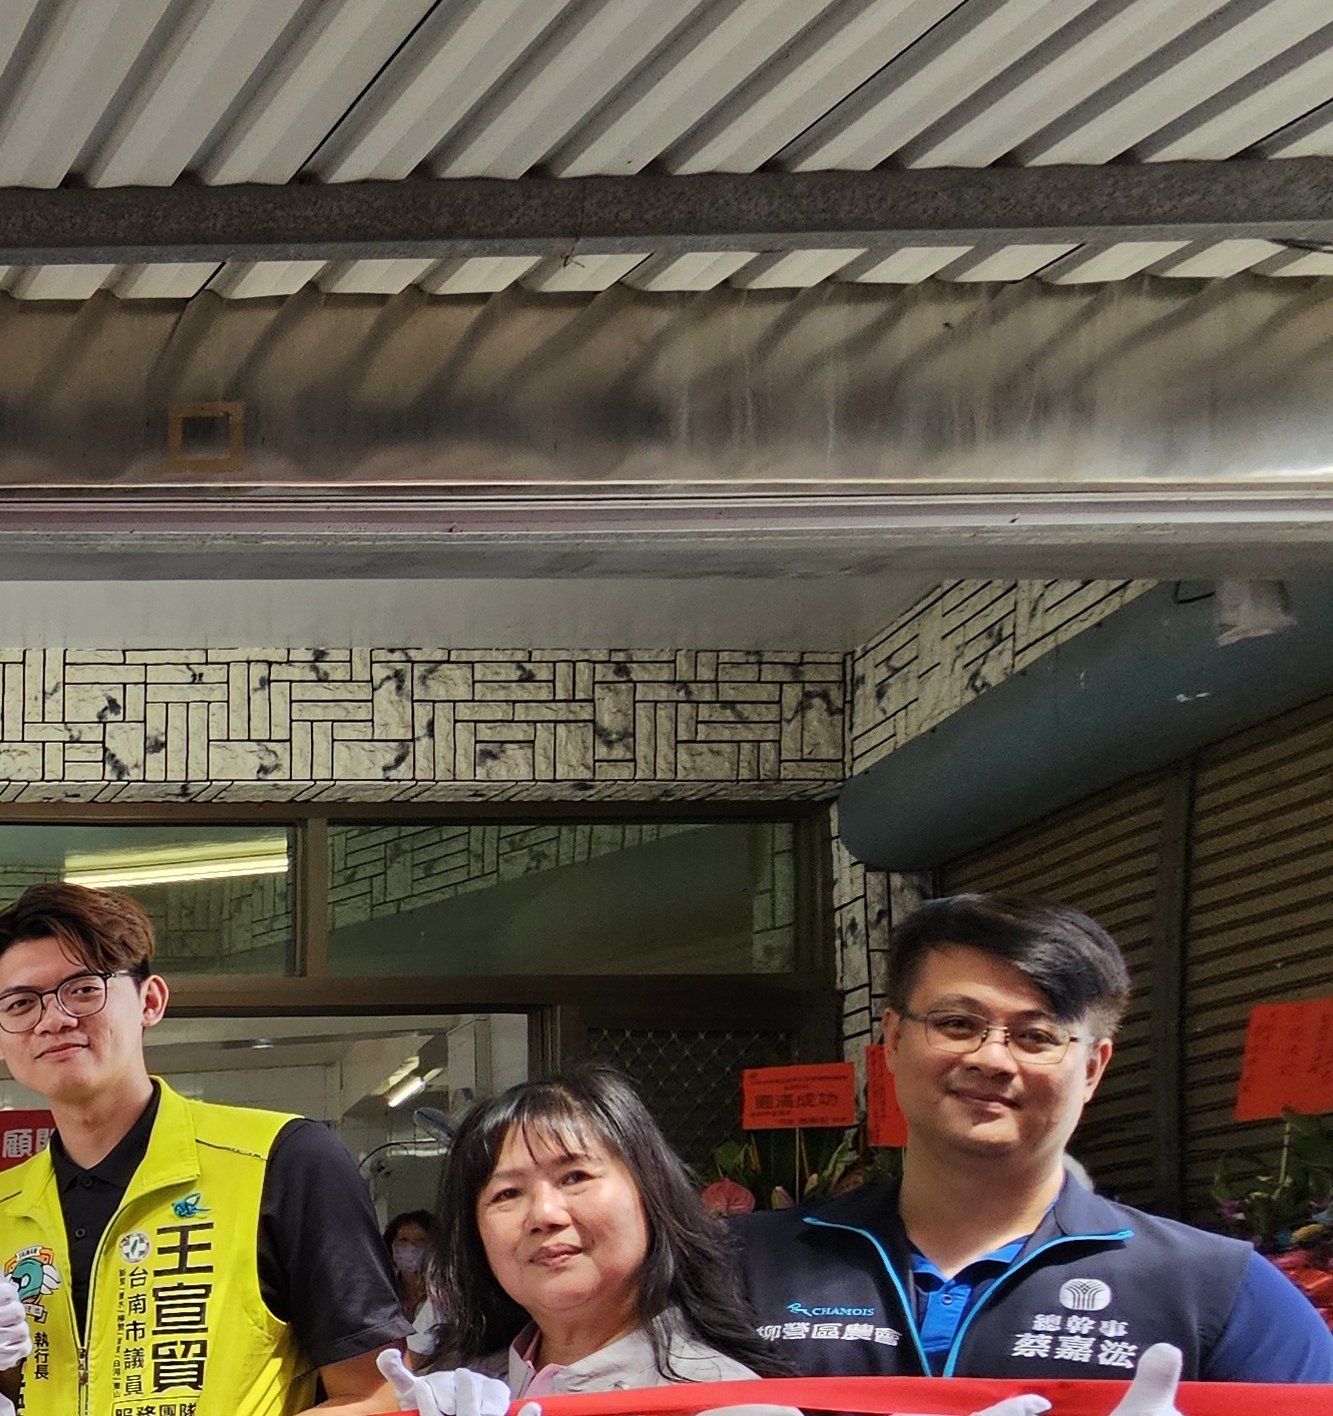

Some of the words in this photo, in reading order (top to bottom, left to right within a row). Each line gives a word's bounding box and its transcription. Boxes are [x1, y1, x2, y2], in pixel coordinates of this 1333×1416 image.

[123, 1266, 149, 1396] 台南市議員
[151, 1222, 214, 1393] 王宣貿
[812, 1307, 875, 1316] CHAMOIS
[1032, 1314, 1129, 1337] 總幹事
[34, 1331, 50, 1380] 執行長
